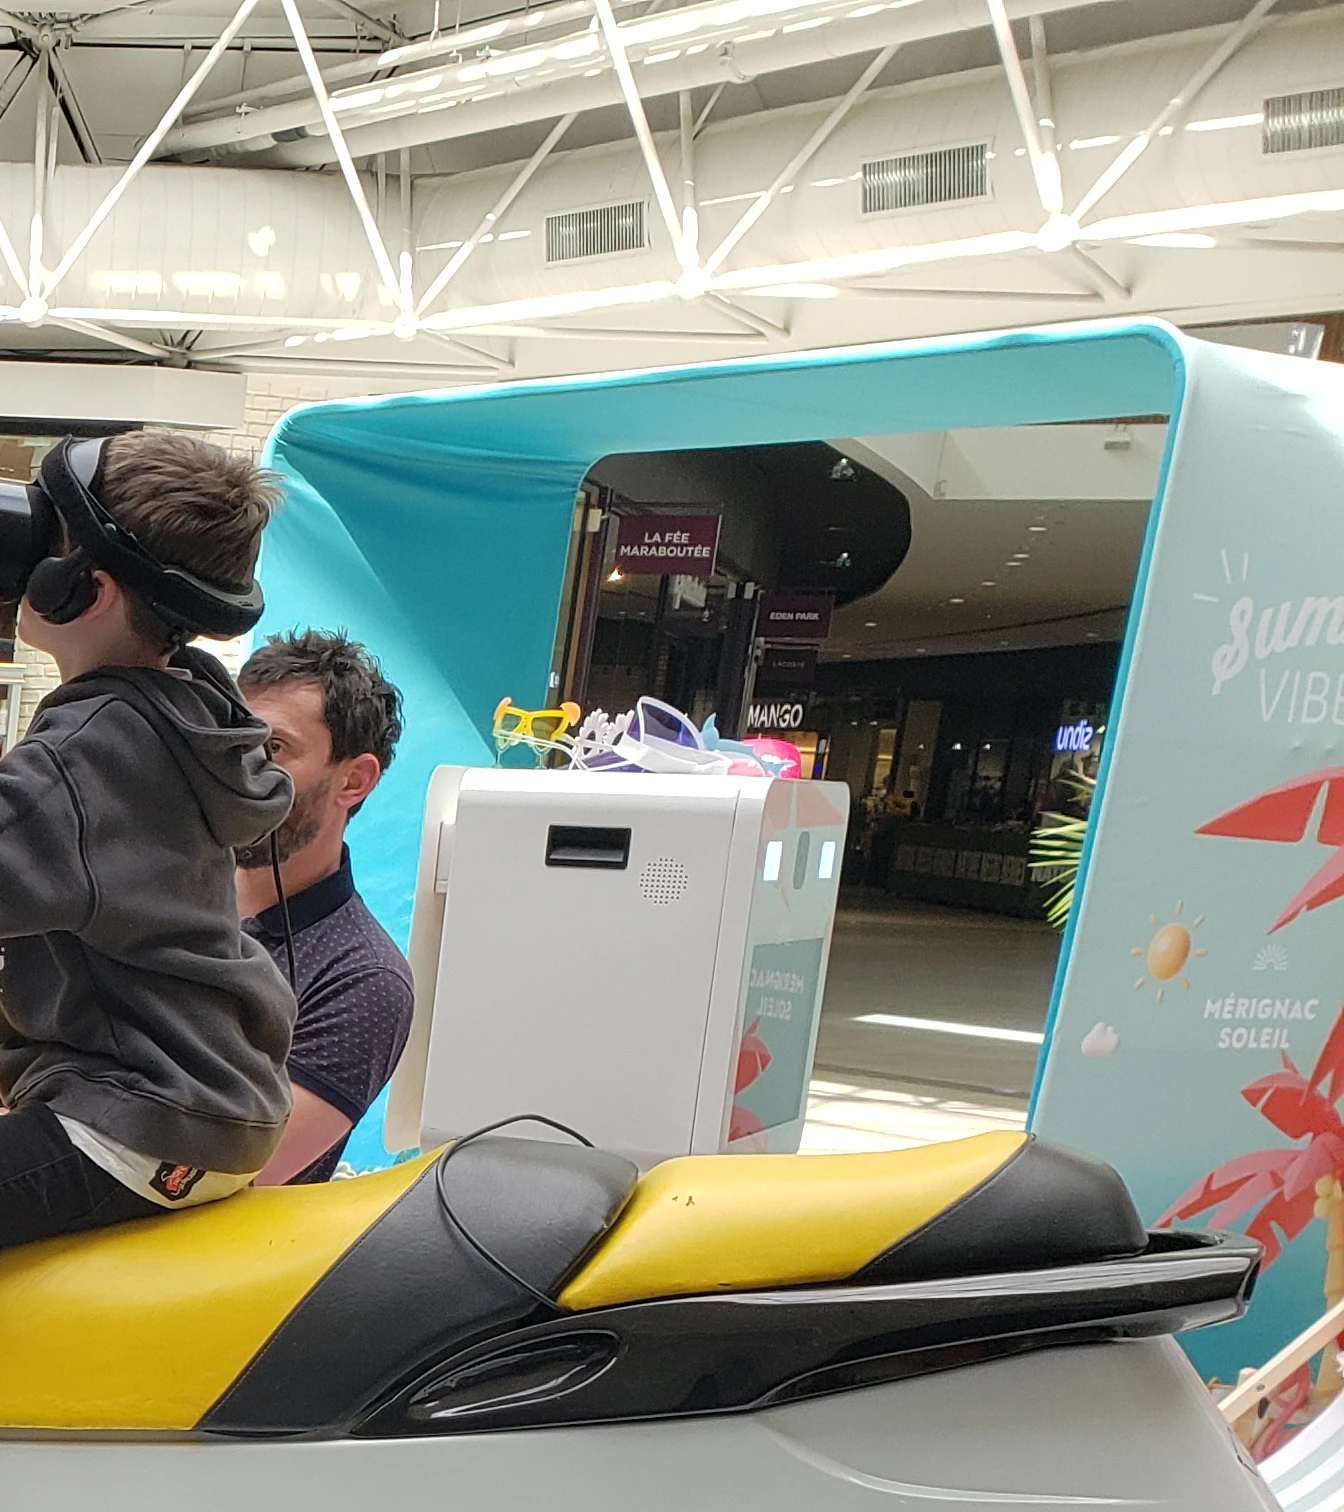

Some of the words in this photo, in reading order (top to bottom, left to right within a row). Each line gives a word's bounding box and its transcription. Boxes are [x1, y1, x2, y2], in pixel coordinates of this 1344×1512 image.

[644, 532, 661, 543] LA
[664, 530, 690, 543] FÉE
[620, 544, 711, 557] MARABOUTÉE
[769, 612, 793, 620] EDEN
[795, 612, 819, 620] PARK
[747, 704, 803, 728] MANGO
[1057, 718, 1093, 751] undiz
[1203, 992, 1320, 1020] MÉRIGNAC
[1218, 1027, 1290, 1048] SOLEIL
